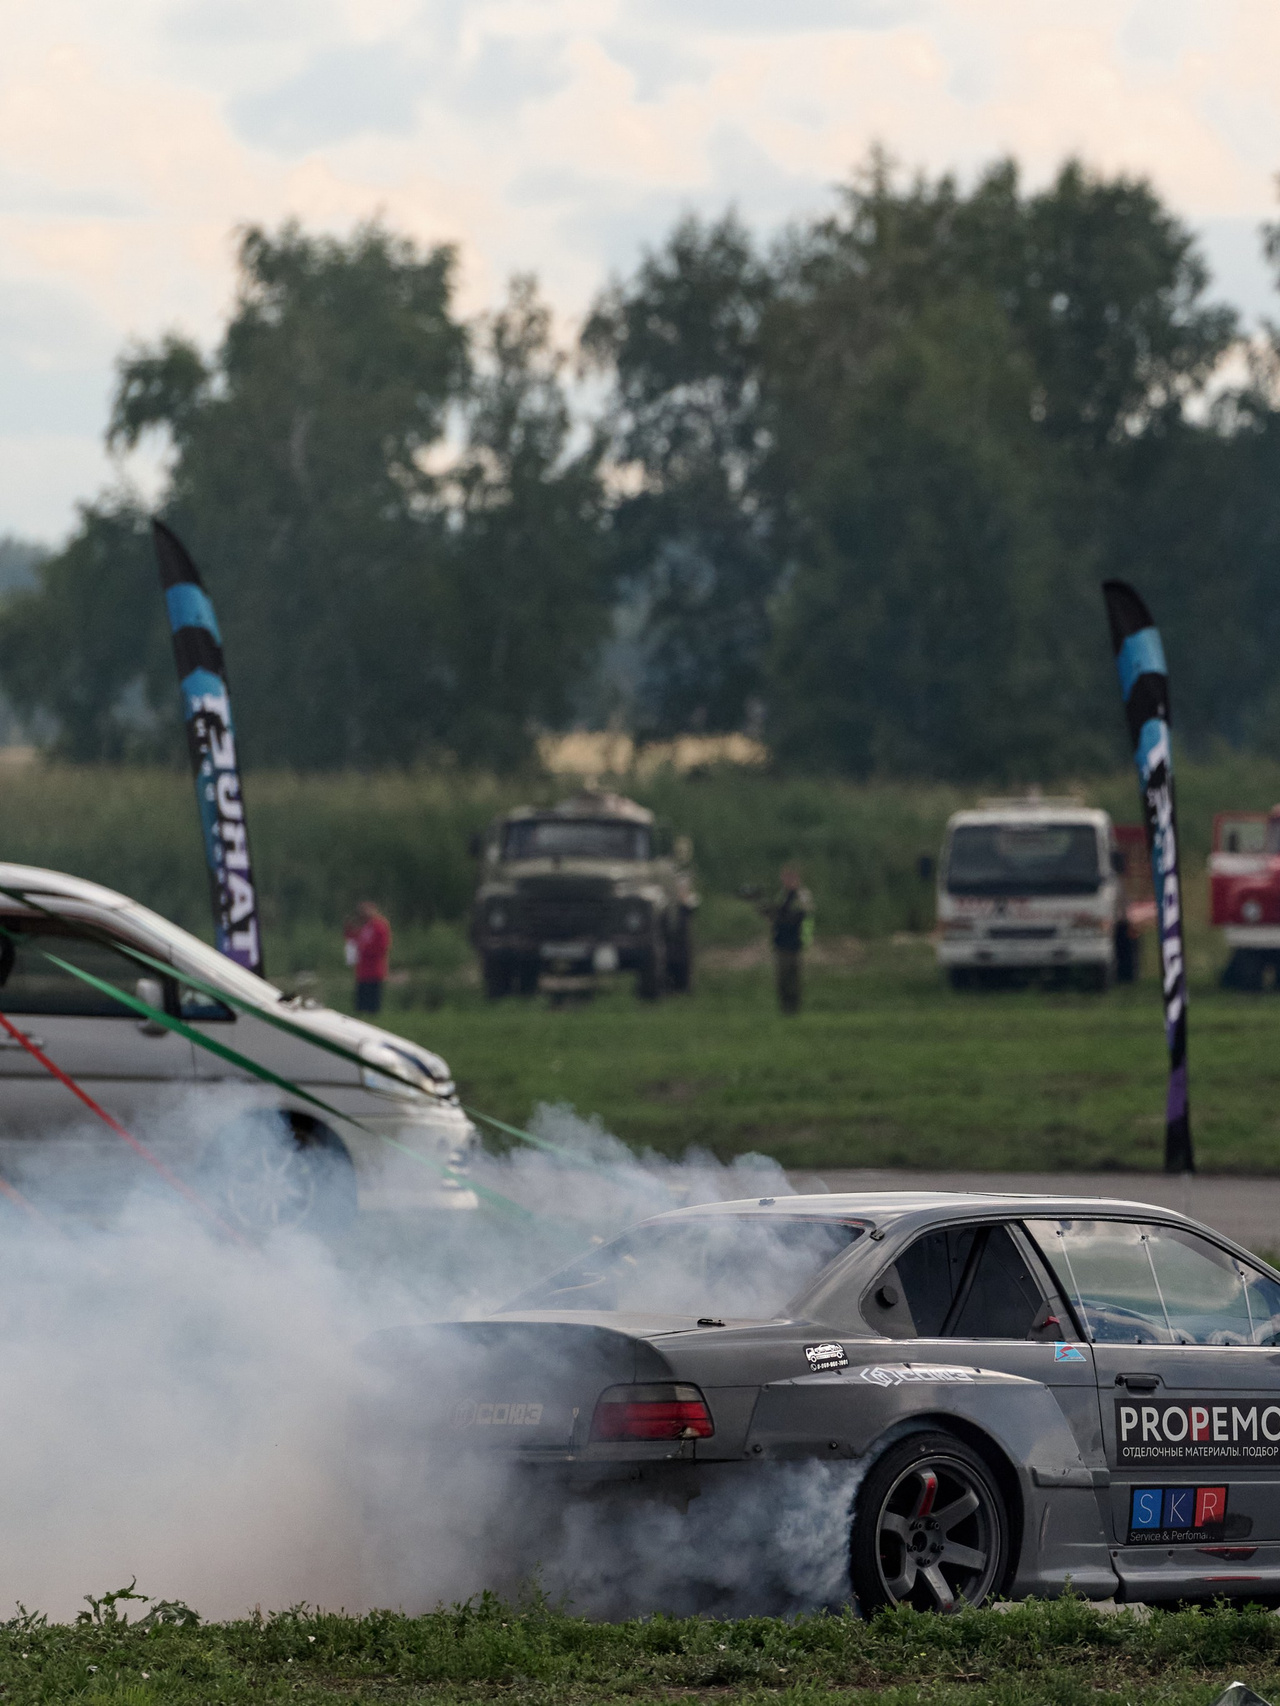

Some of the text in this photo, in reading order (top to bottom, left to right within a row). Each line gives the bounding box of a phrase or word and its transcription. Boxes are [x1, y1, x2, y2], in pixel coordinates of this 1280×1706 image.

[1122, 1447, 1183, 1458] ОТДЕЛОЧНЫЕ
[1242, 1446, 1278, 1457] ПОДБОР
[1130, 1531, 1160, 1542] Service
[1162, 1531, 1170, 1541] &
